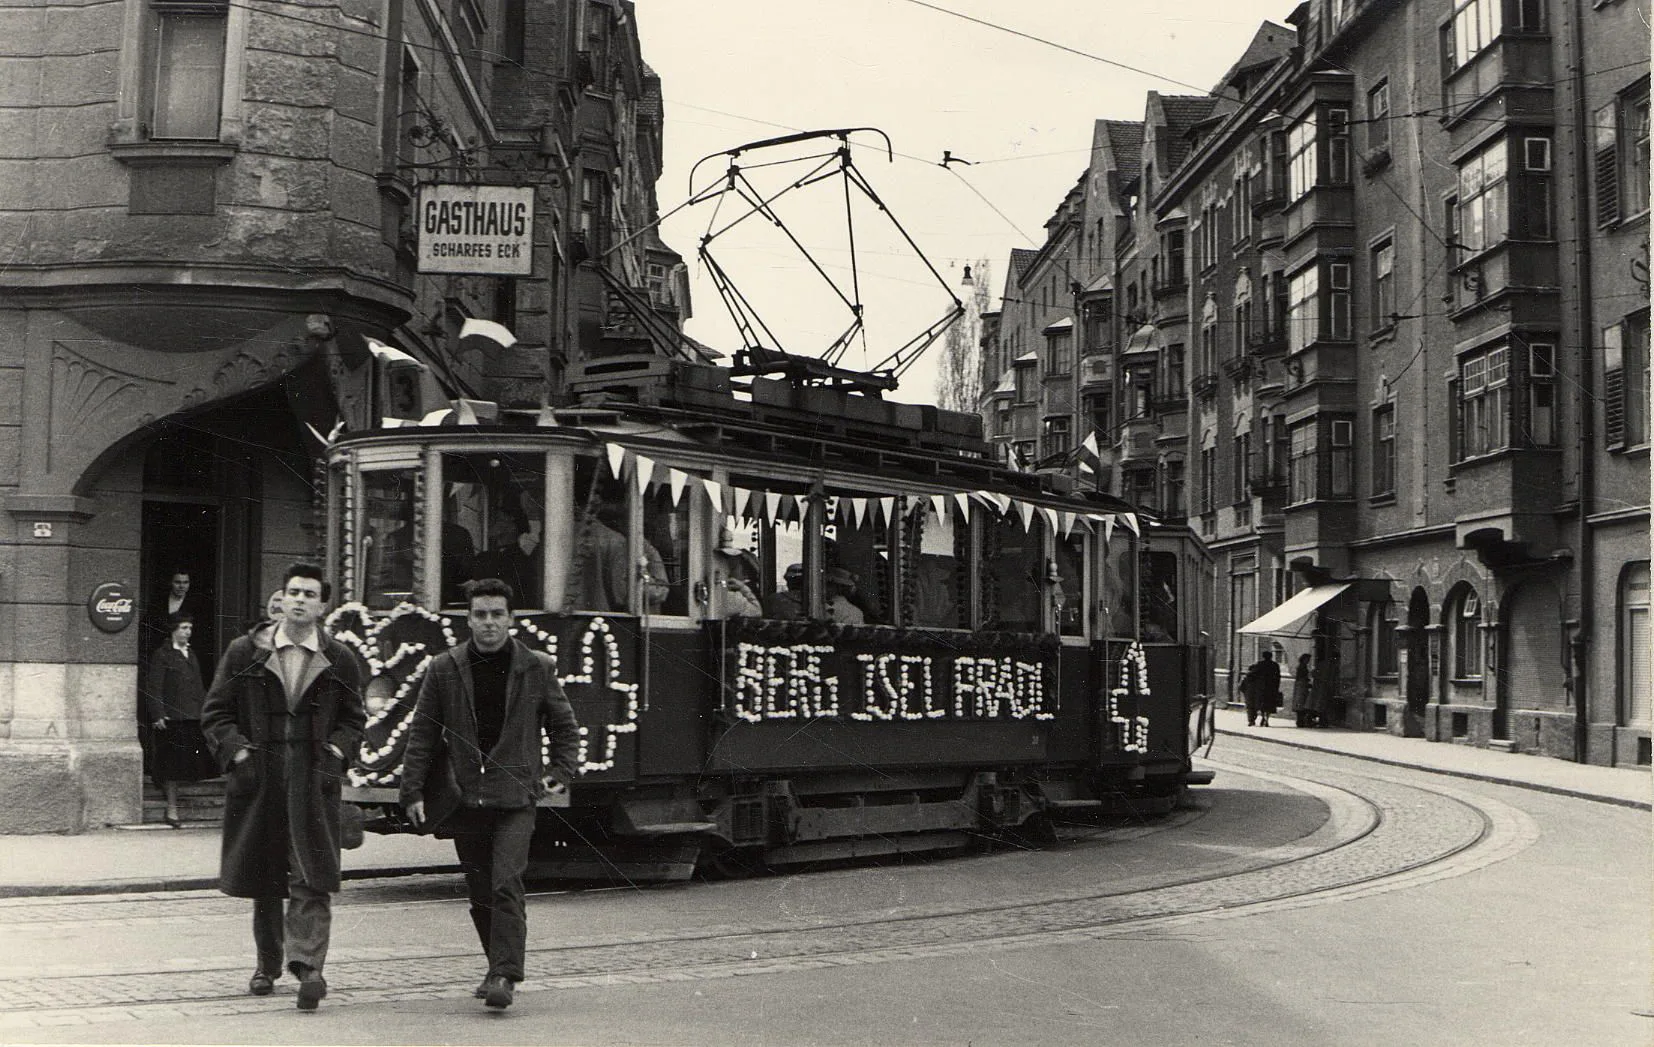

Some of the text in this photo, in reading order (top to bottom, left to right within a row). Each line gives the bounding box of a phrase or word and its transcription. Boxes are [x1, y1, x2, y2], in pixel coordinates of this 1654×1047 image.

[425, 200, 526, 237] GASTHAUS
[432, 243, 492, 258] SCHARFES
[735, 642, 839, 723] BERG
[851, 653, 946, 720] ISEL
